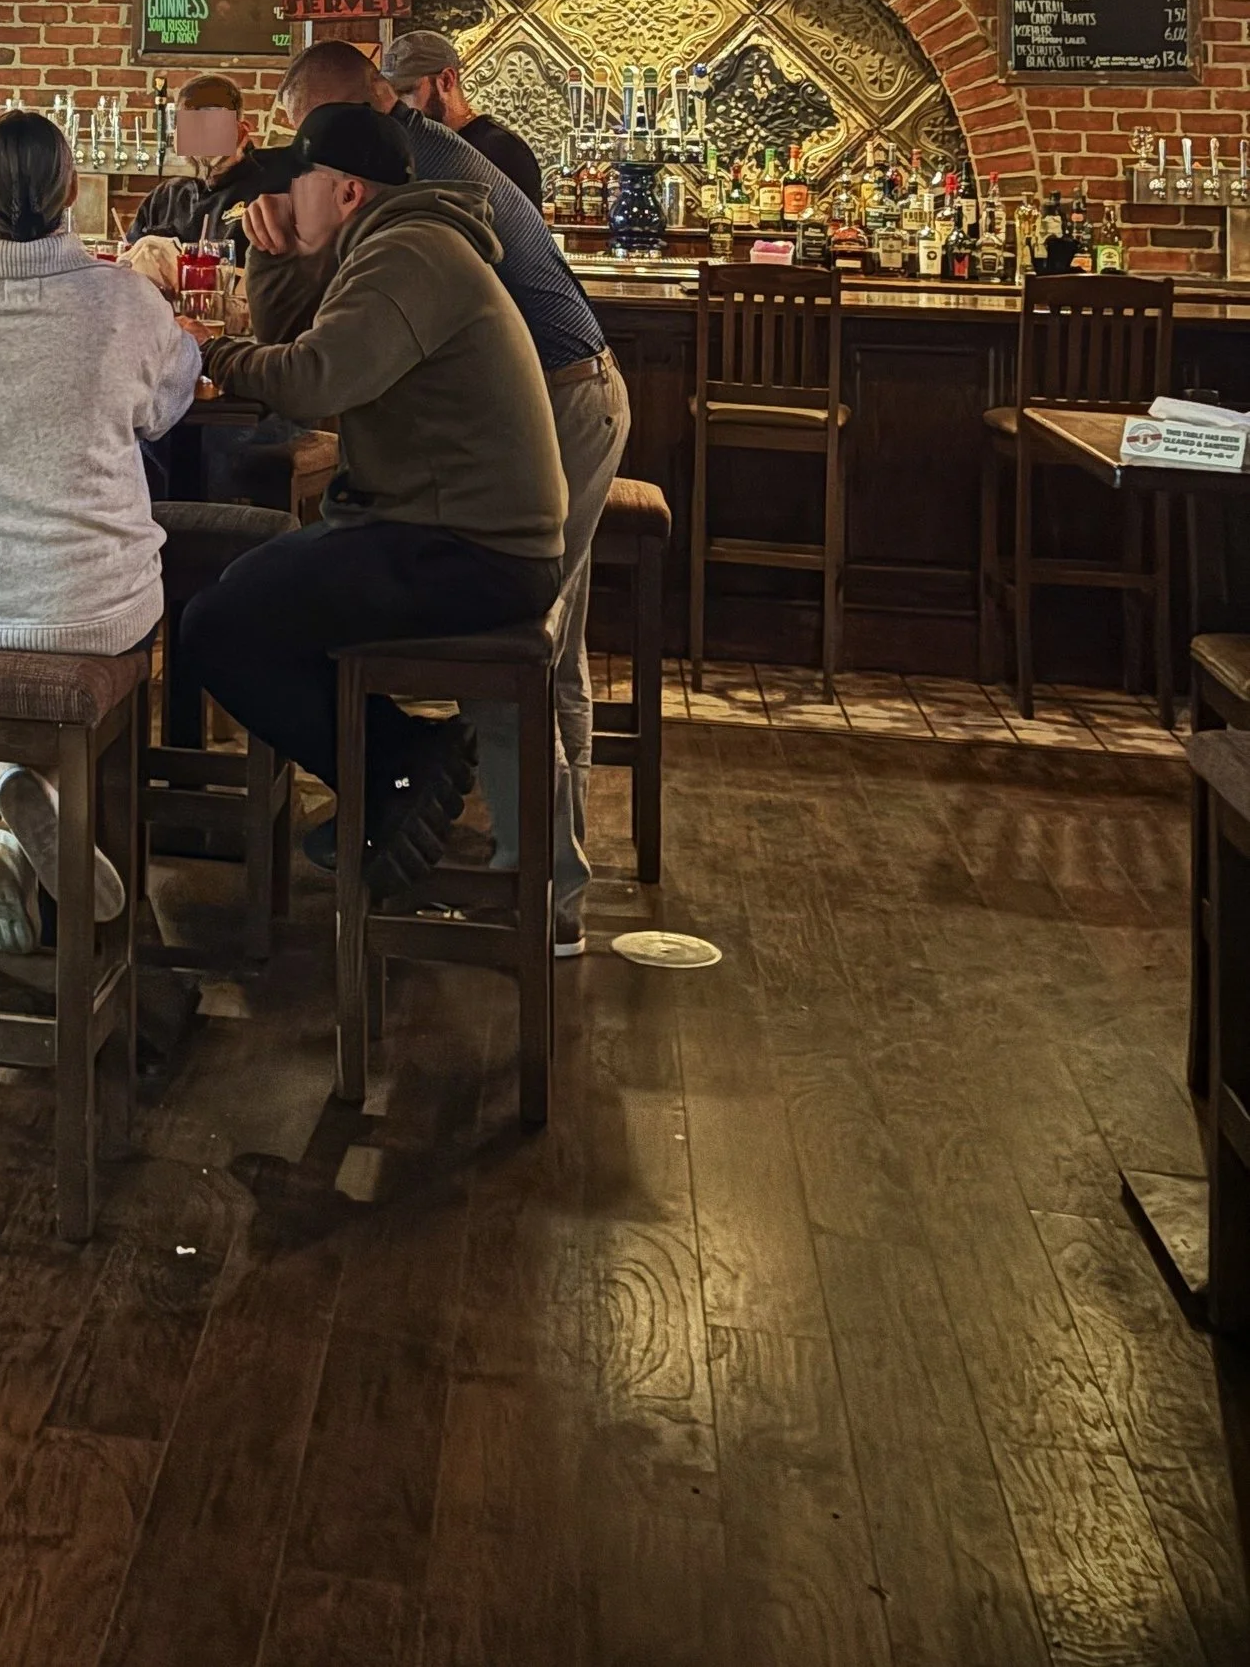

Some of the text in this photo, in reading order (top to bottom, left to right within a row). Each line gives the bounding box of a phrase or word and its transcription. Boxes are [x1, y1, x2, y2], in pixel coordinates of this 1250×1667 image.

[1014, 0, 1065, 13] NEW TRAIL
[1030, 11, 1097, 26] CANDY HEARTS
[167, 19, 200, 33] RUSSELL
[1026, 55, 1056, 68] BLACK
